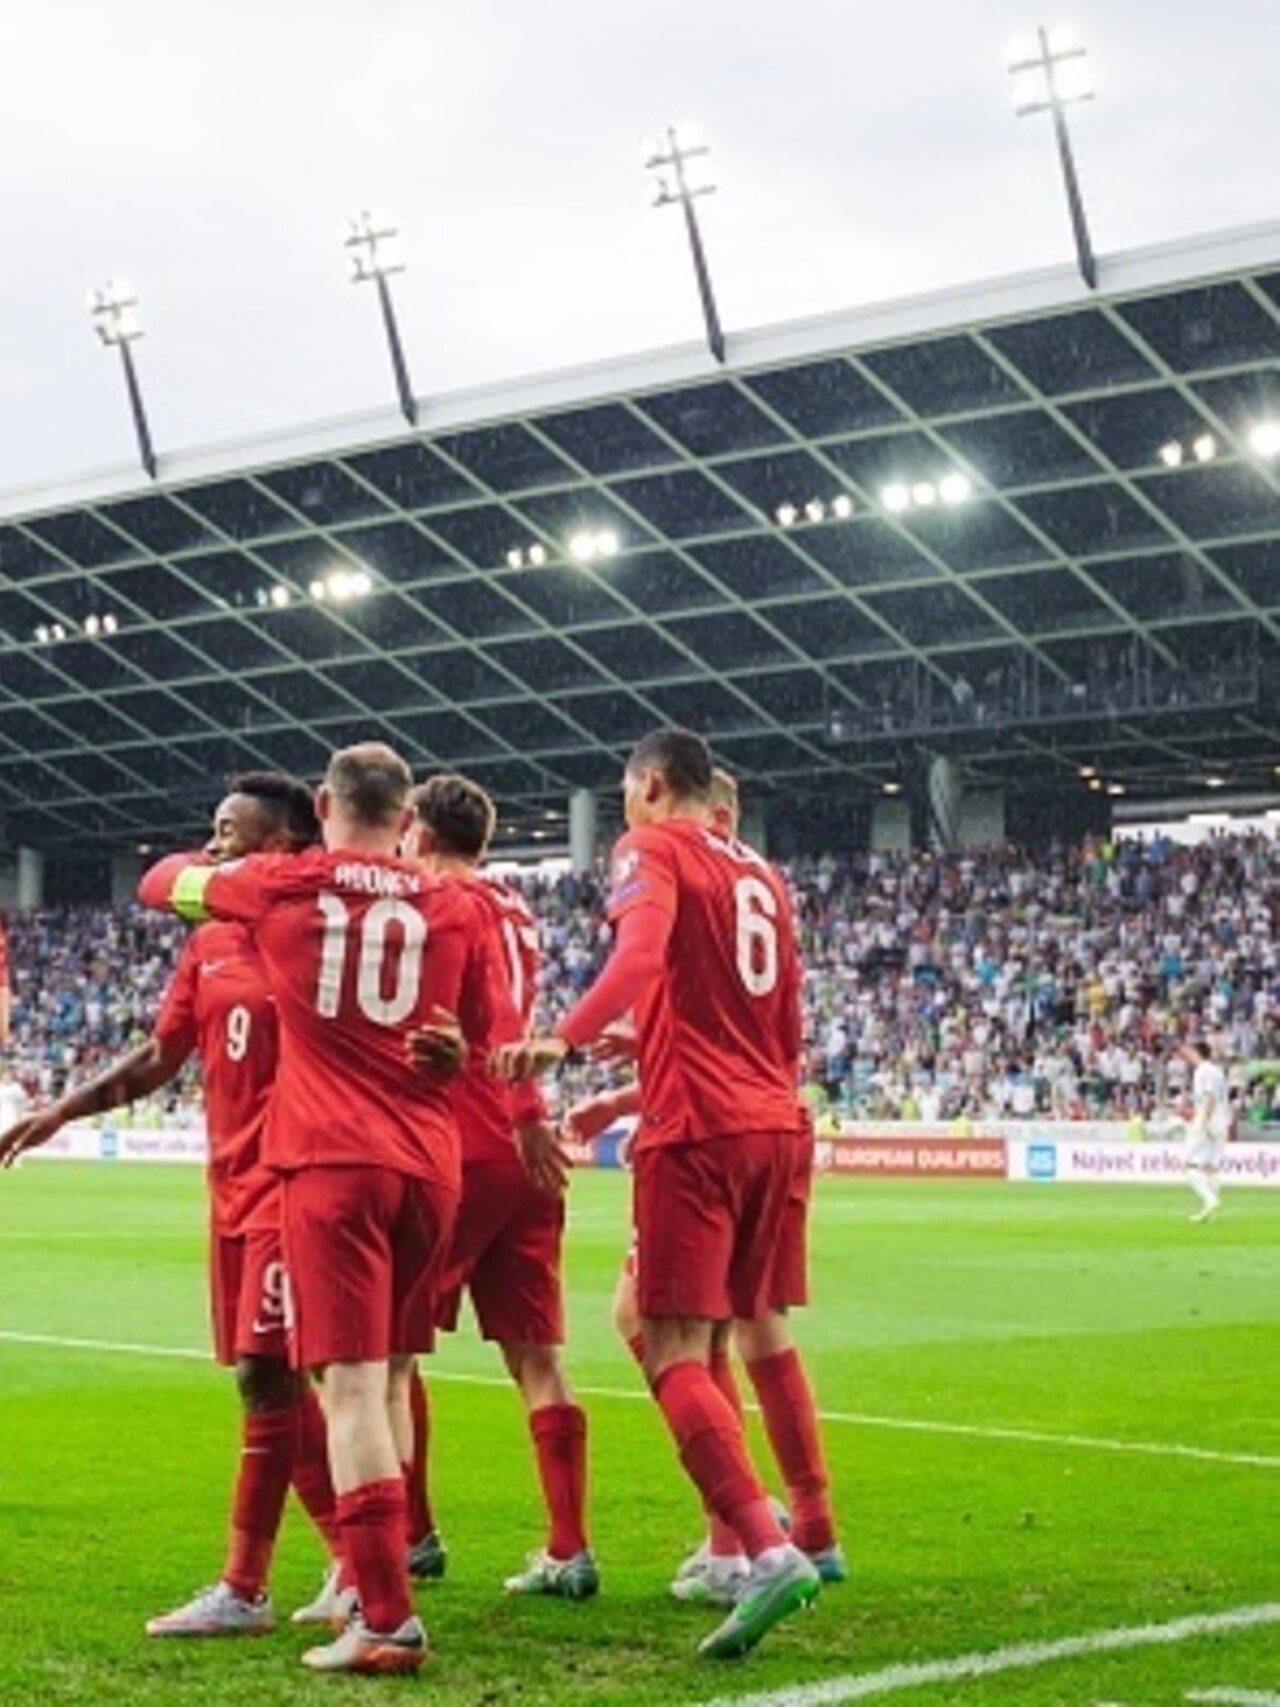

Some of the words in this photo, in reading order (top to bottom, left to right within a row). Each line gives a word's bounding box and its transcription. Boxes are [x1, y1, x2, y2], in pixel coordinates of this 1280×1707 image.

[317, 890, 427, 1027] 10
[734, 876, 777, 996] 6
[227, 1006, 250, 1062] 9
[835, 1149, 914, 1170] EUROPEAN
[918, 1150, 1005, 1171] QUALIFIERS
[262, 1262, 294, 1330] 9
